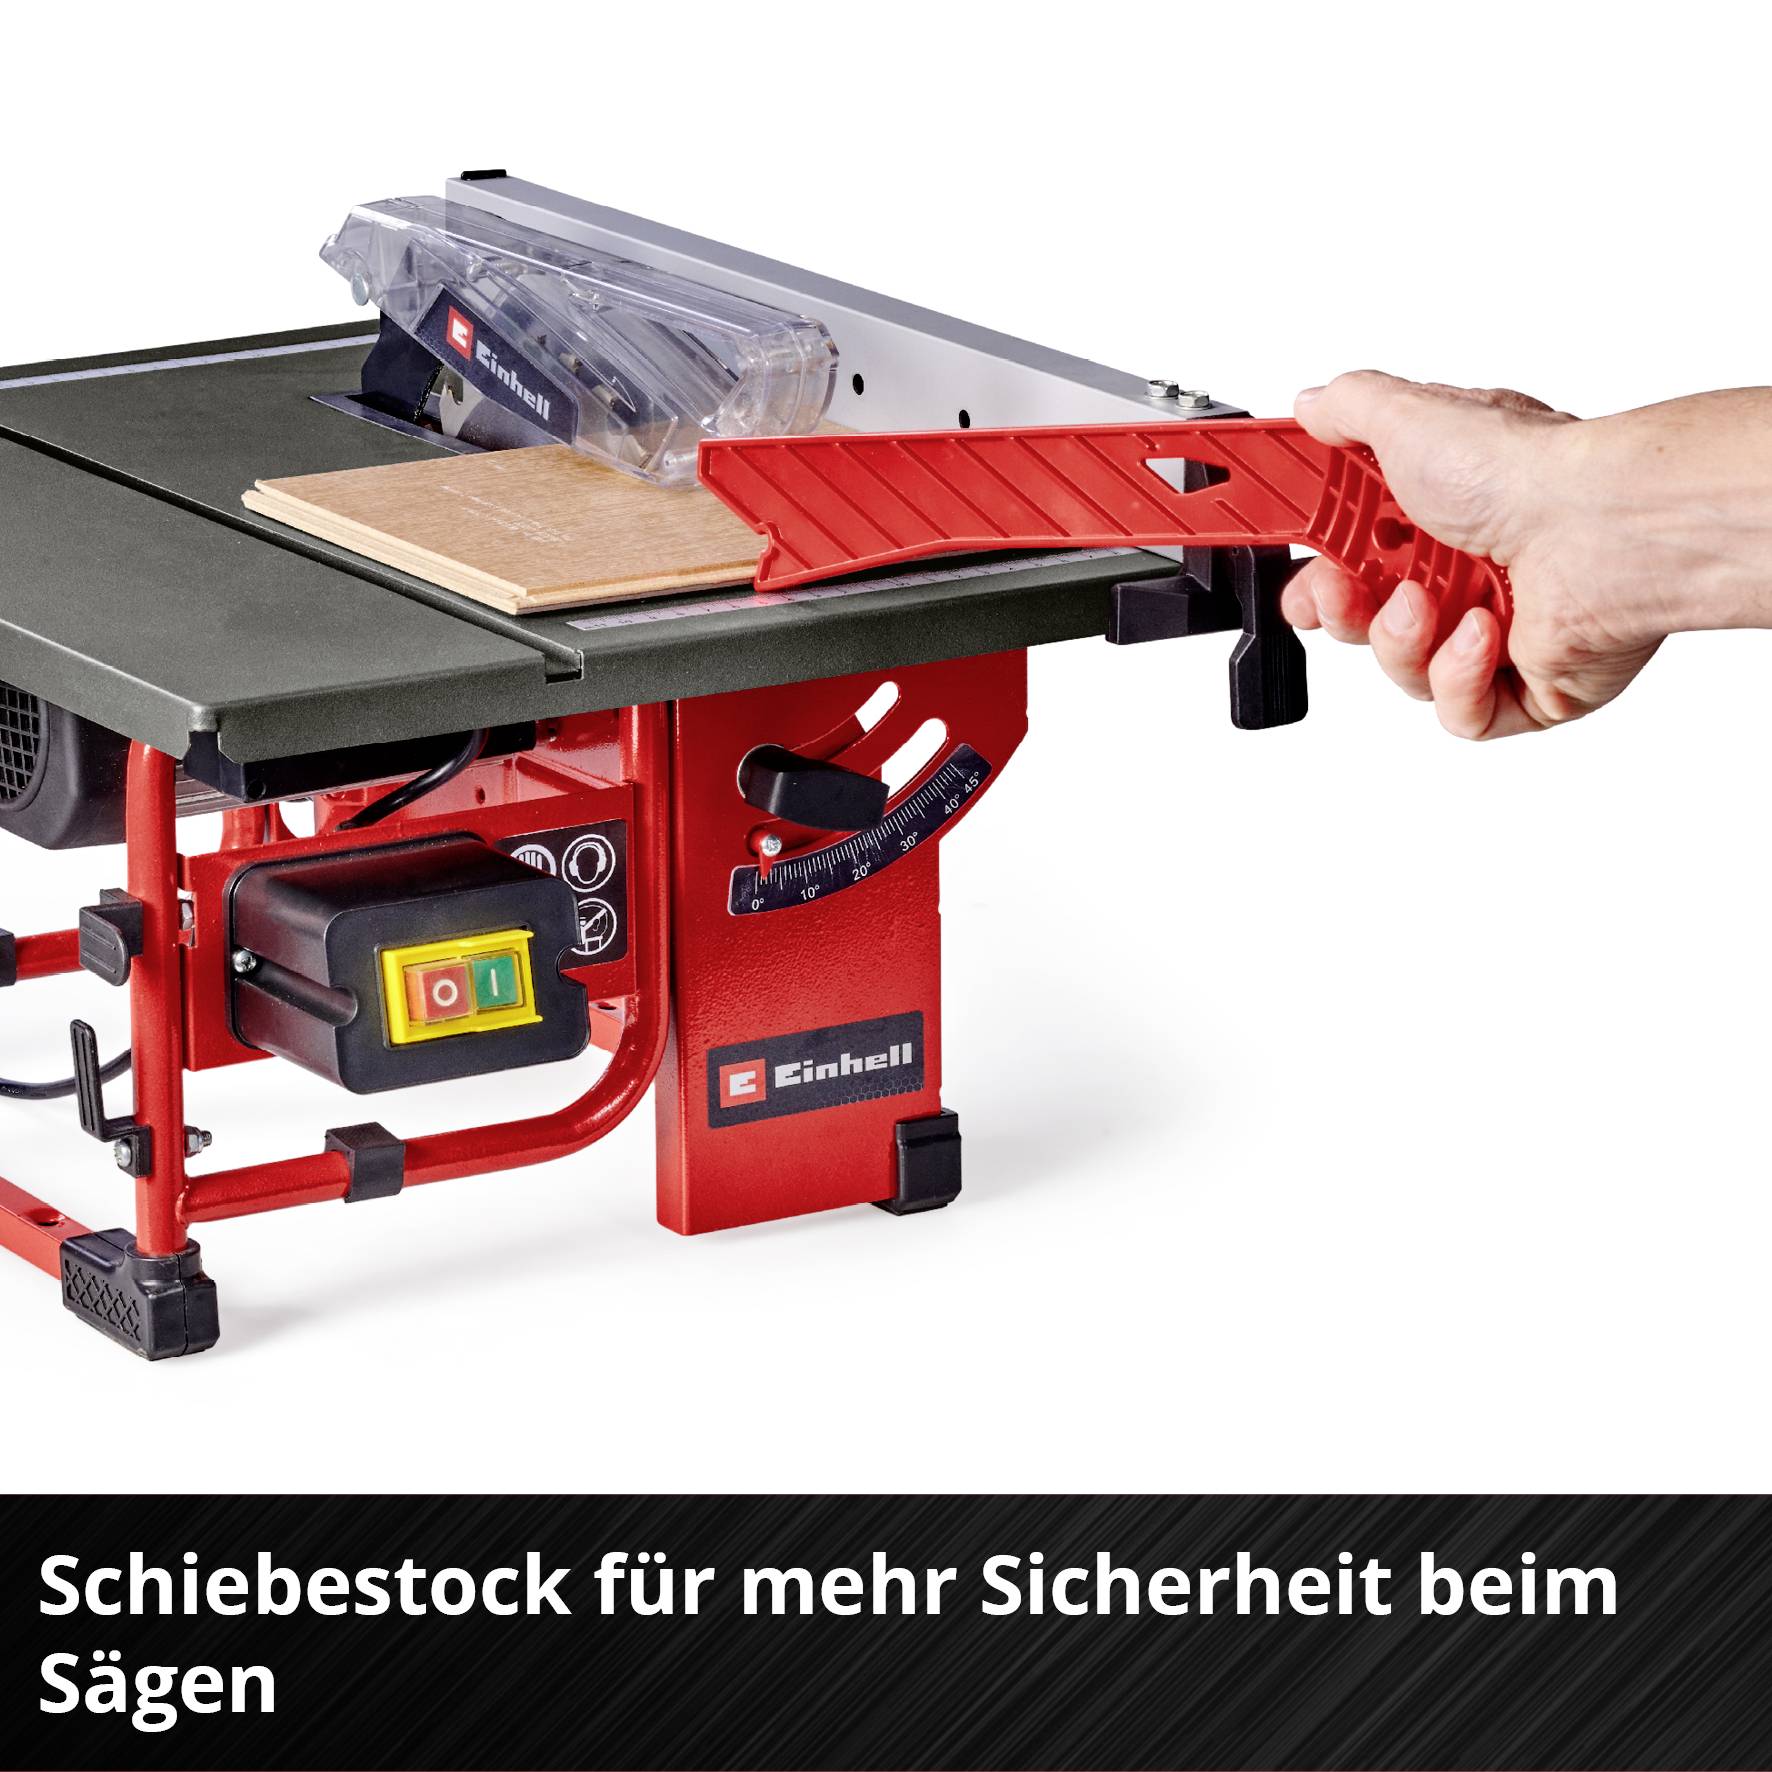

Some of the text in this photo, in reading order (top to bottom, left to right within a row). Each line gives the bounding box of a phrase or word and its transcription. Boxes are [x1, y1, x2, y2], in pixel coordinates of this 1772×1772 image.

[475, 340, 550, 421] Einhell
[852, 861, 872, 881] 20°
[899, 831, 919, 852] 30°
[944, 793, 961, 815] 40°
[963, 771, 981, 794] 45°
[774, 1042, 912, 1088] Einhell
